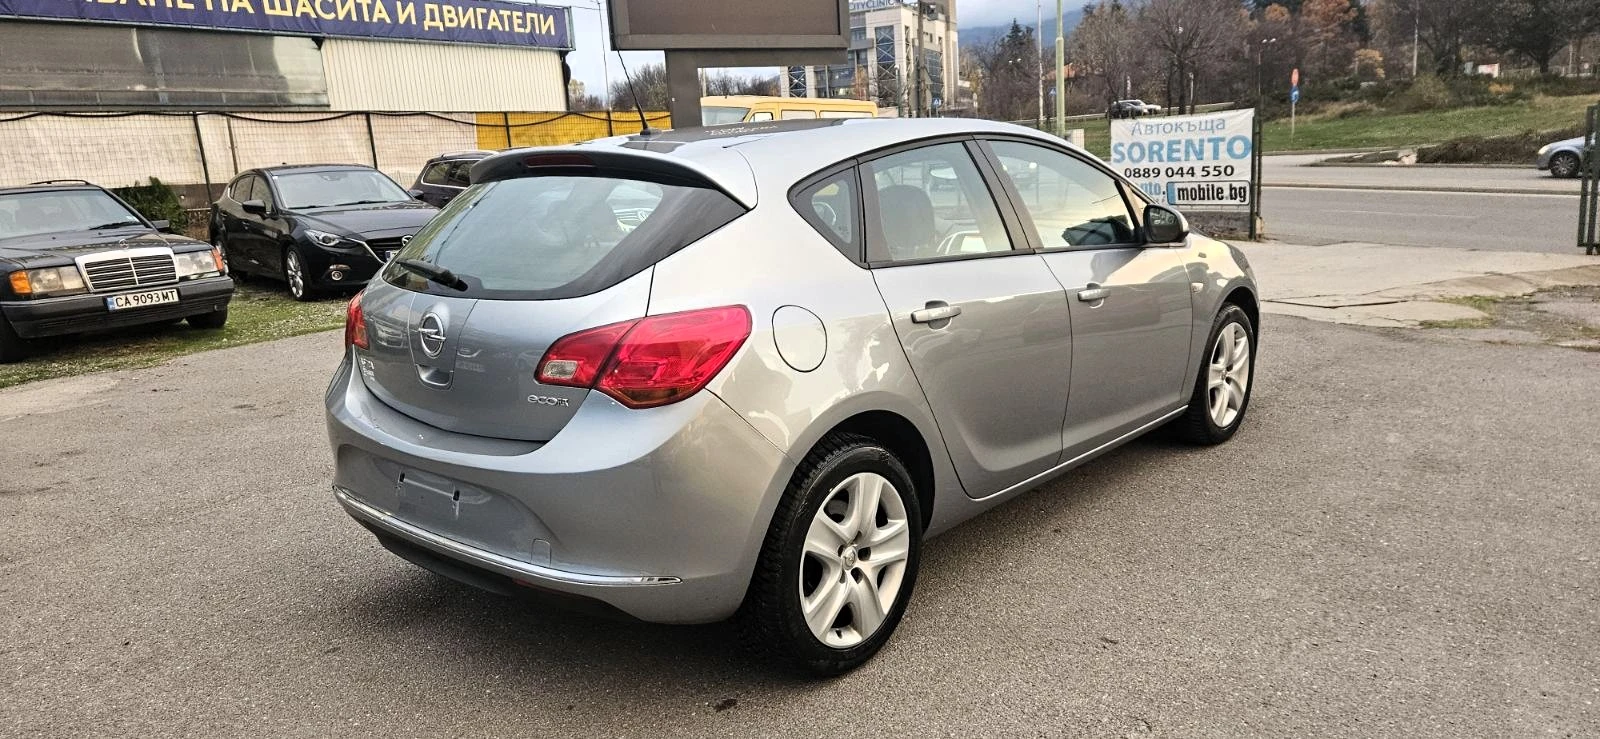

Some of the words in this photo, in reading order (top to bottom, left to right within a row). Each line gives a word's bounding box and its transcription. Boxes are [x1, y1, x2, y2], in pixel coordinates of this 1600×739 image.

[263, 0, 391, 23] ШАСИТА
[397, 0, 416, 25] И
[423, 3, 555, 36] ДВИГАТЕЛИ
[1131, 118, 1226, 136] Автокъща
[1113, 135, 1252, 163] SORENTO
[1124, 168, 1160, 178] 0889
[1165, 167, 1195, 178] 044
[1201, 165, 1235, 177] 550
[1177, 184, 1247, 202] mobile.bg
